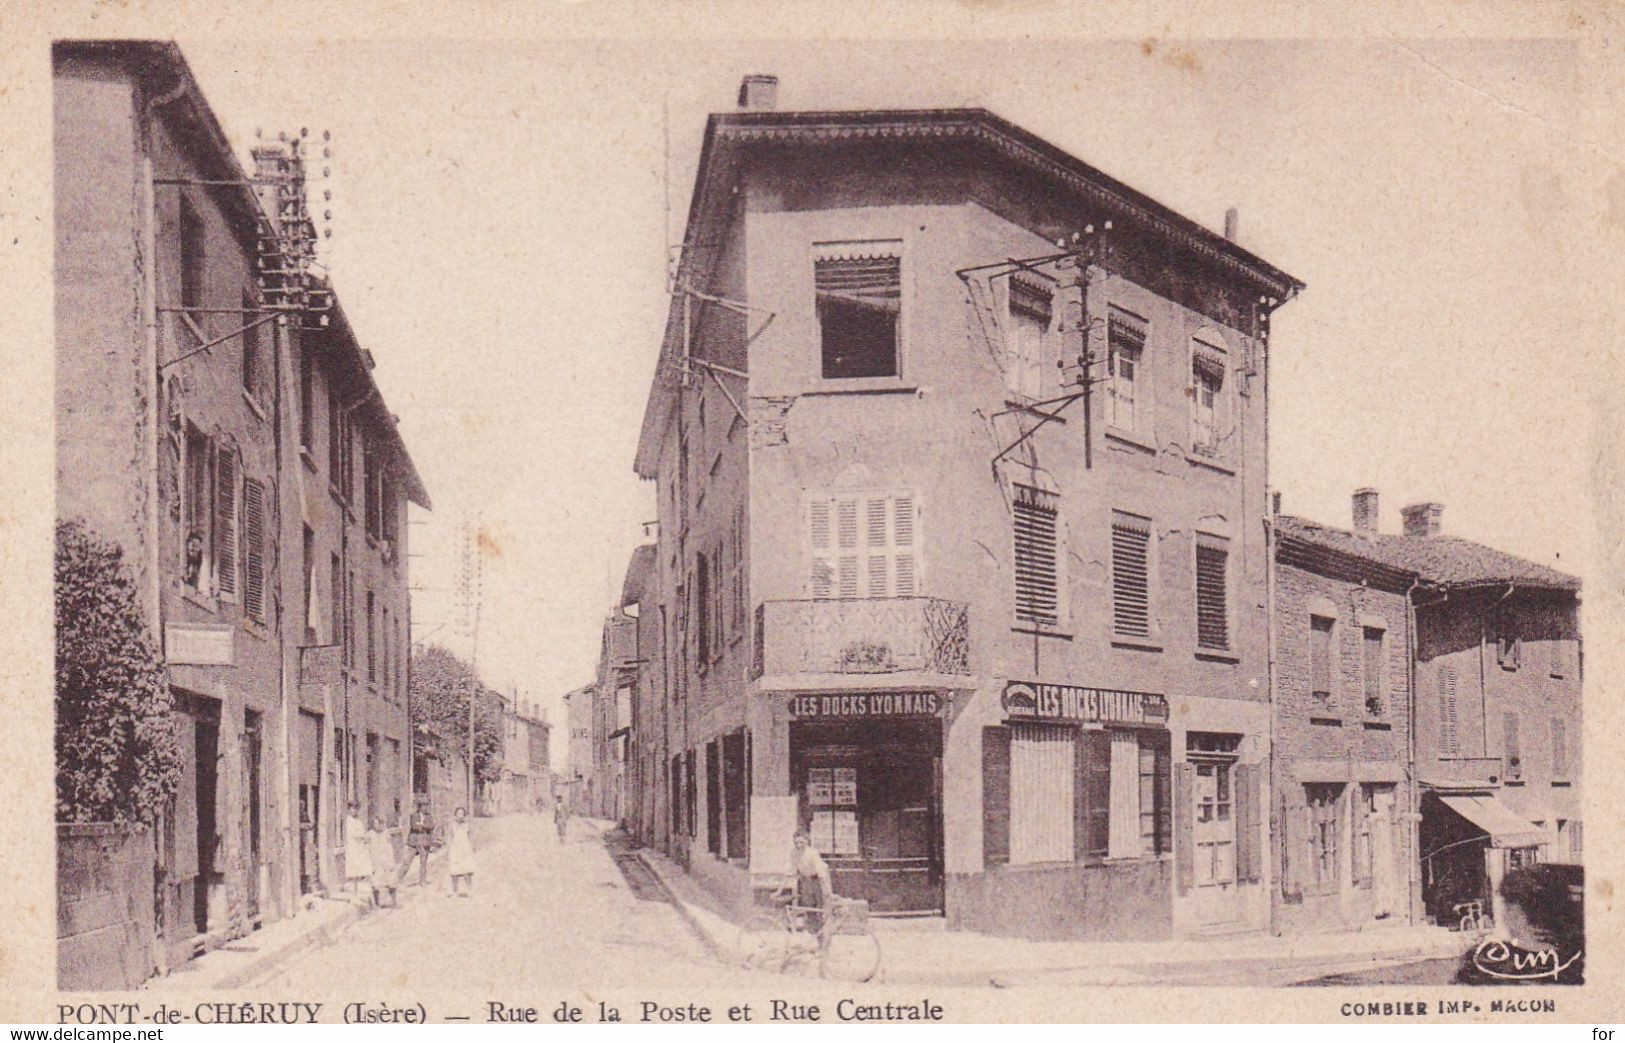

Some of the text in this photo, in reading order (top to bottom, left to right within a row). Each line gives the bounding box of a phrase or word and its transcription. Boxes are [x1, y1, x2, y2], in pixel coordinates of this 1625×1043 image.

[795, 694, 936, 716] LES DOCKS LYONNAIS
[1037, 685, 1060, 717] LES
[1061, 687, 1098, 720] DOCKS
